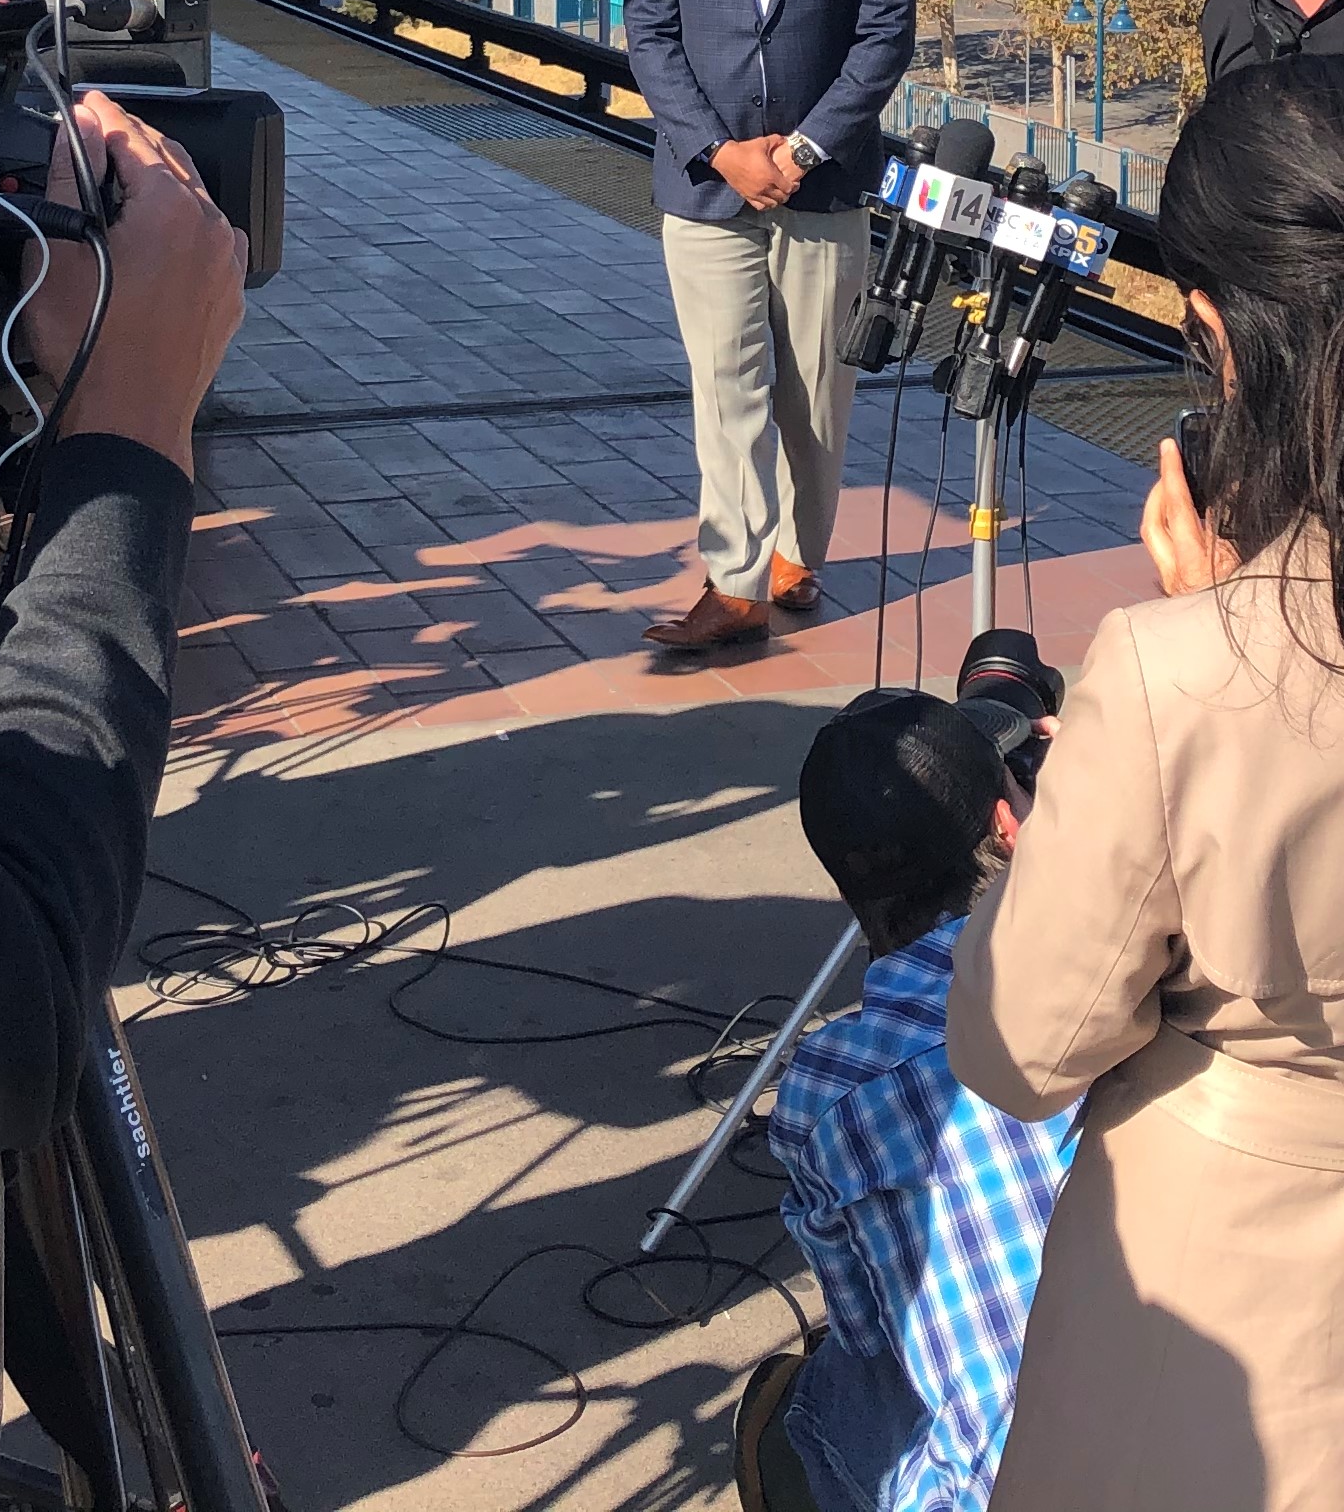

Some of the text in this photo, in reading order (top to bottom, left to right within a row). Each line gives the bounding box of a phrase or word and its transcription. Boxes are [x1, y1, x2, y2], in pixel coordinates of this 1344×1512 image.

[951, 188, 984, 226] 14
[987, 206, 1021, 230] NBC
[1075, 224, 1101, 255] 5
[1050, 244, 1092, 268] KPIX
